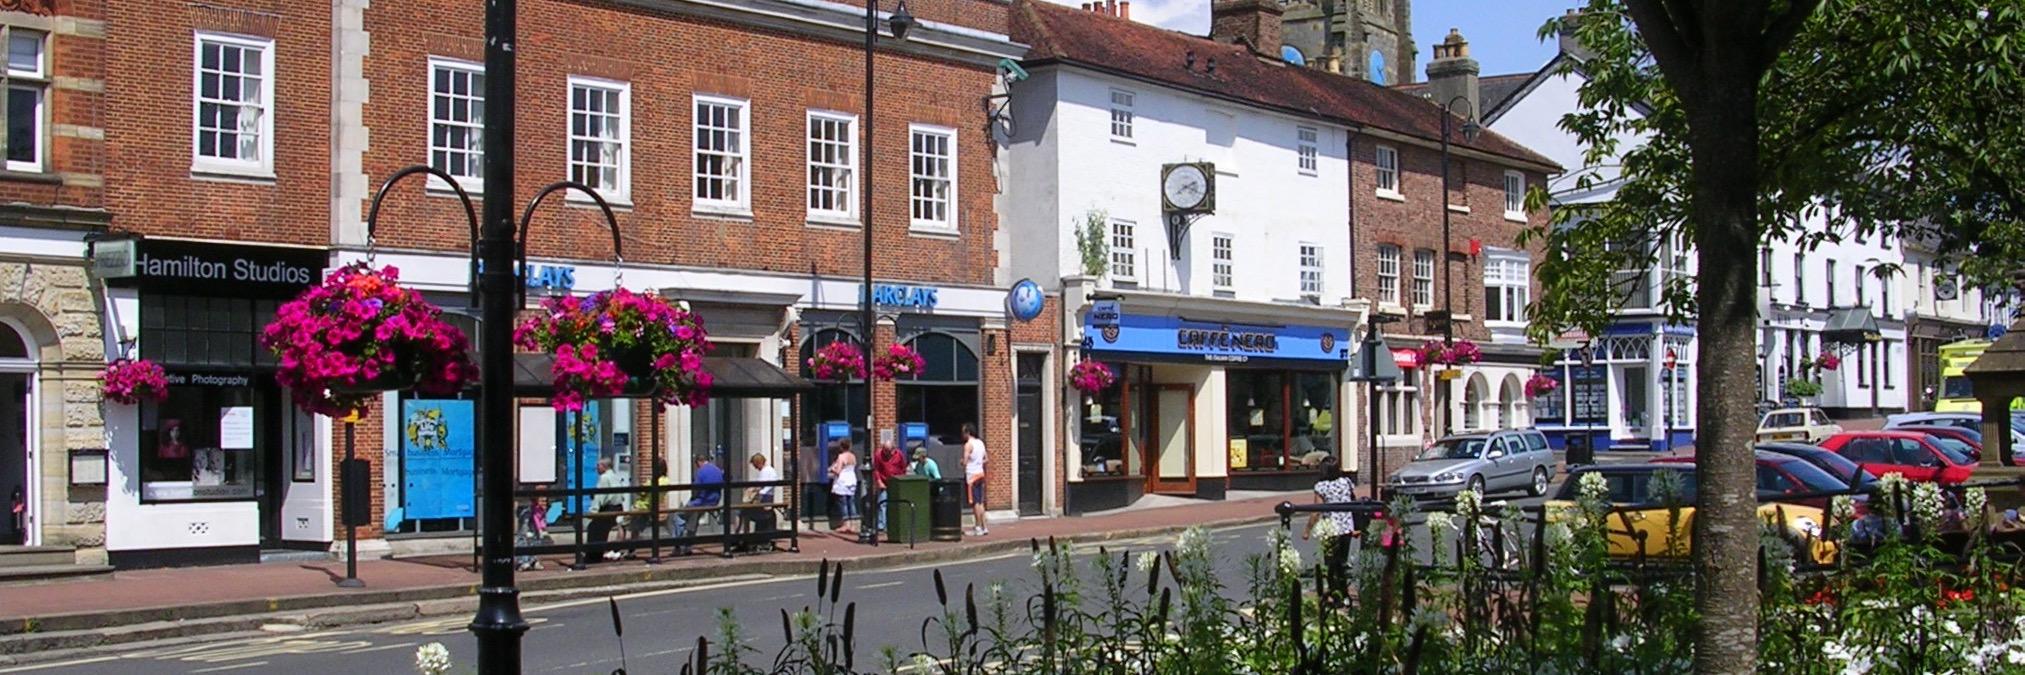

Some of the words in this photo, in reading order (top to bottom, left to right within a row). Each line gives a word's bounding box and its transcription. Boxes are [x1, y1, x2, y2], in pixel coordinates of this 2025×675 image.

[136, 252, 226, 279] Hamilton
[234, 258, 311, 284] Studios
[1231, 332, 1279, 353] NERO
[191, 373, 249, 387] Photography
